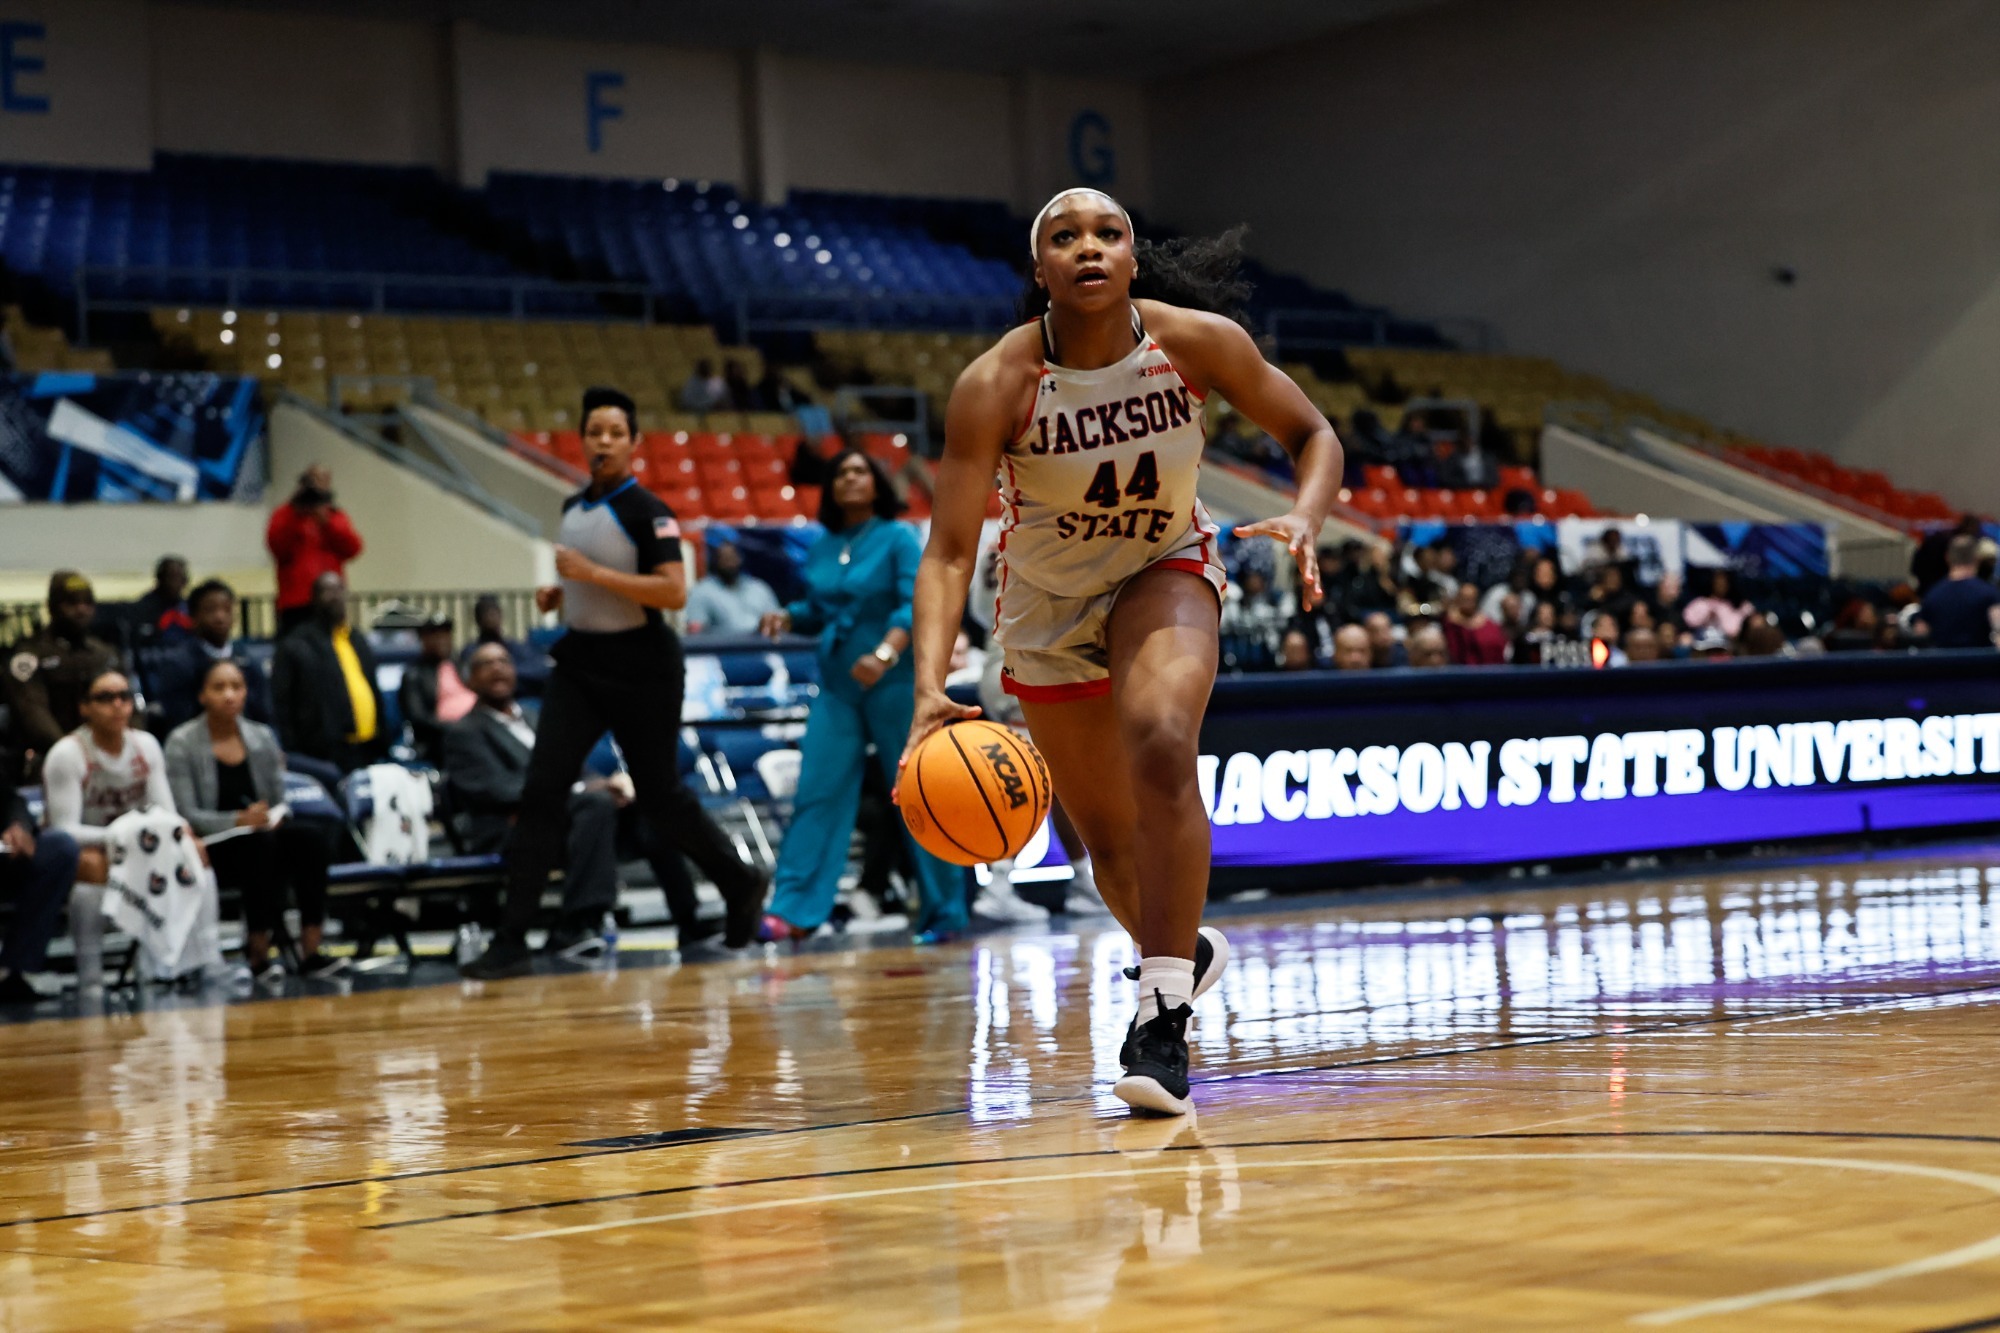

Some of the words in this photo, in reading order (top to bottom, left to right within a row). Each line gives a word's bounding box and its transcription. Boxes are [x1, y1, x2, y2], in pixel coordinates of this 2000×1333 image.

[1, 20, 50, 113] E
[585, 70, 625, 151] F
[1069, 109, 1115, 187] G
[1147, 363, 1175, 377] SWA
[1030, 386, 1192, 455] JACKSON
[1083, 450, 1161, 508] 44
[1057, 508, 1175, 544] STATE
[981, 742, 1029, 811] NCAA
[1497, 728, 1706, 808] STATE
